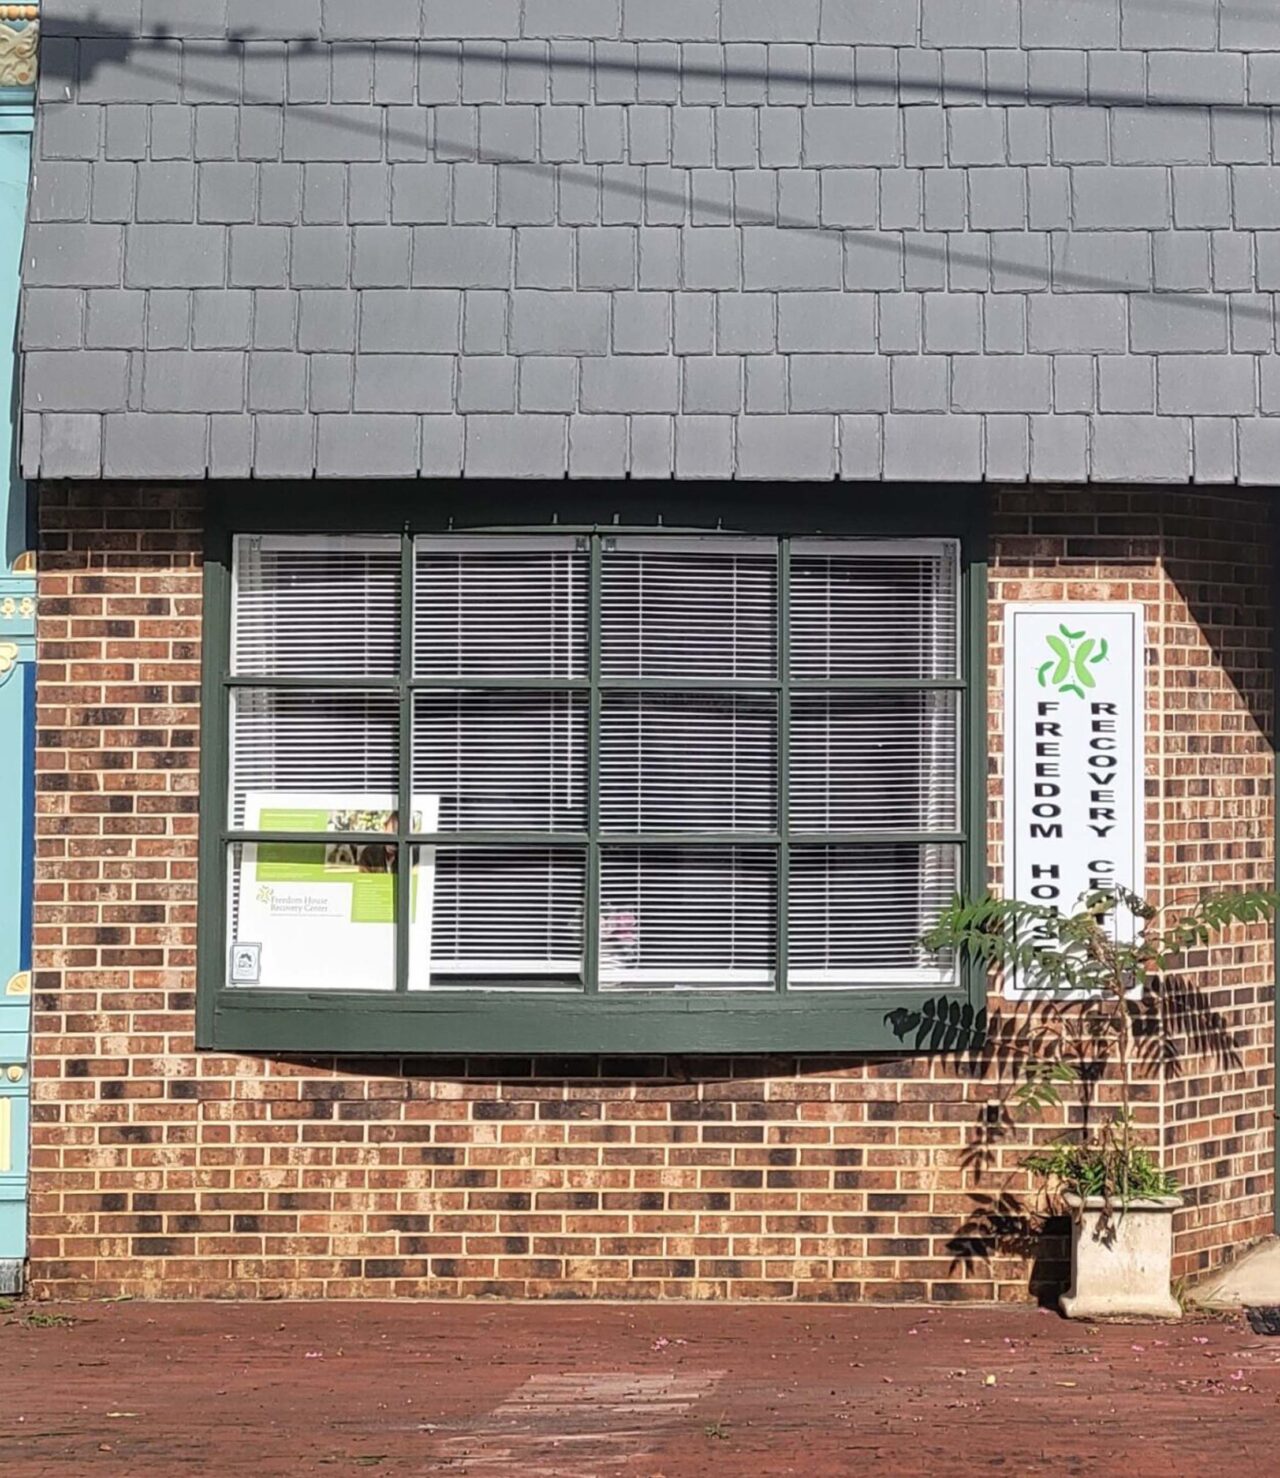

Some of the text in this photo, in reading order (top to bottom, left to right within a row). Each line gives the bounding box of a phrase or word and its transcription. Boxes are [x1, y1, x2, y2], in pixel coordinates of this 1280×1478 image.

[1030, 701, 1063, 839] FREEDOM
[1087, 702, 1118, 838] RECOVERY
[270, 904, 328, 913] Recovery Center
[271, 895, 328, 905] Freedom House
